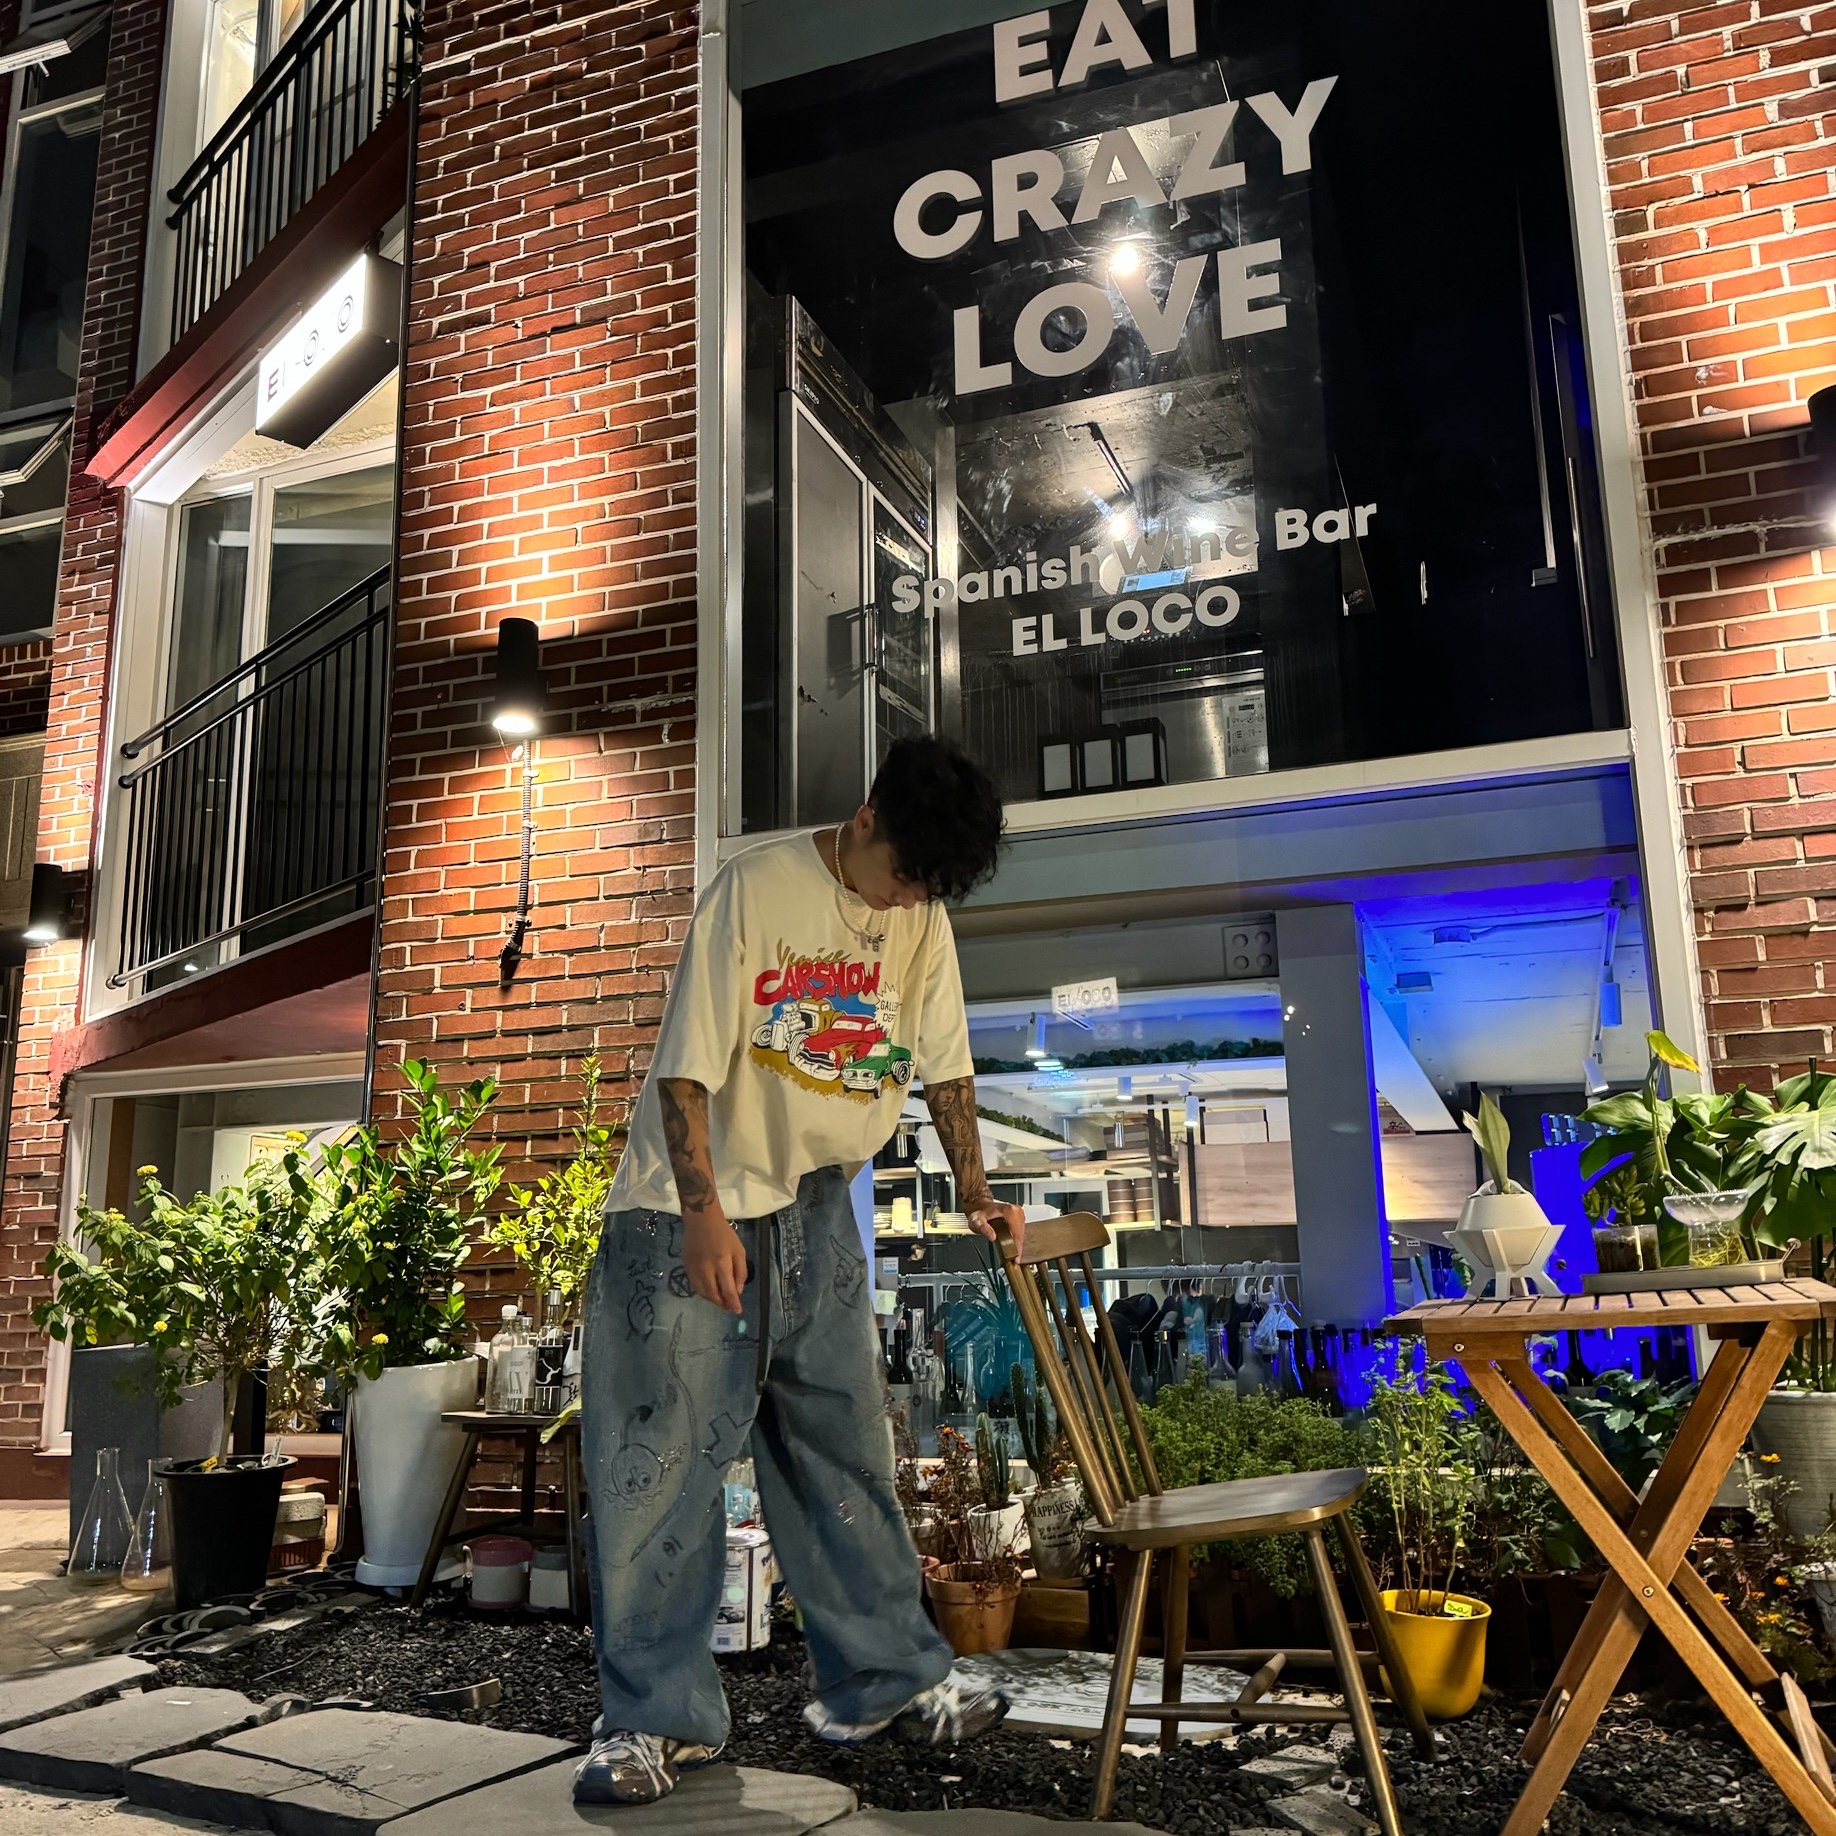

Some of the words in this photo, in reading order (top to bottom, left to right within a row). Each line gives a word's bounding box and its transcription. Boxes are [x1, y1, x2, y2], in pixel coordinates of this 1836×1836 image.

[893, 75, 1339, 259] CRAZY
[953, 238, 1287, 395] LOVE
[891, 545, 1101, 619] Spanish
[1113, 526, 1260, 575] Wine
[1275, 503, 1377, 551] Bar
[1012, 613, 1068, 656] EL
[1080, 585, 1240, 647] LOCO
[754, 961, 881, 1006] CARSHOW
[777, 937, 852, 970] Venice
[1031, 1499, 1074, 1518] HAPPINESS
